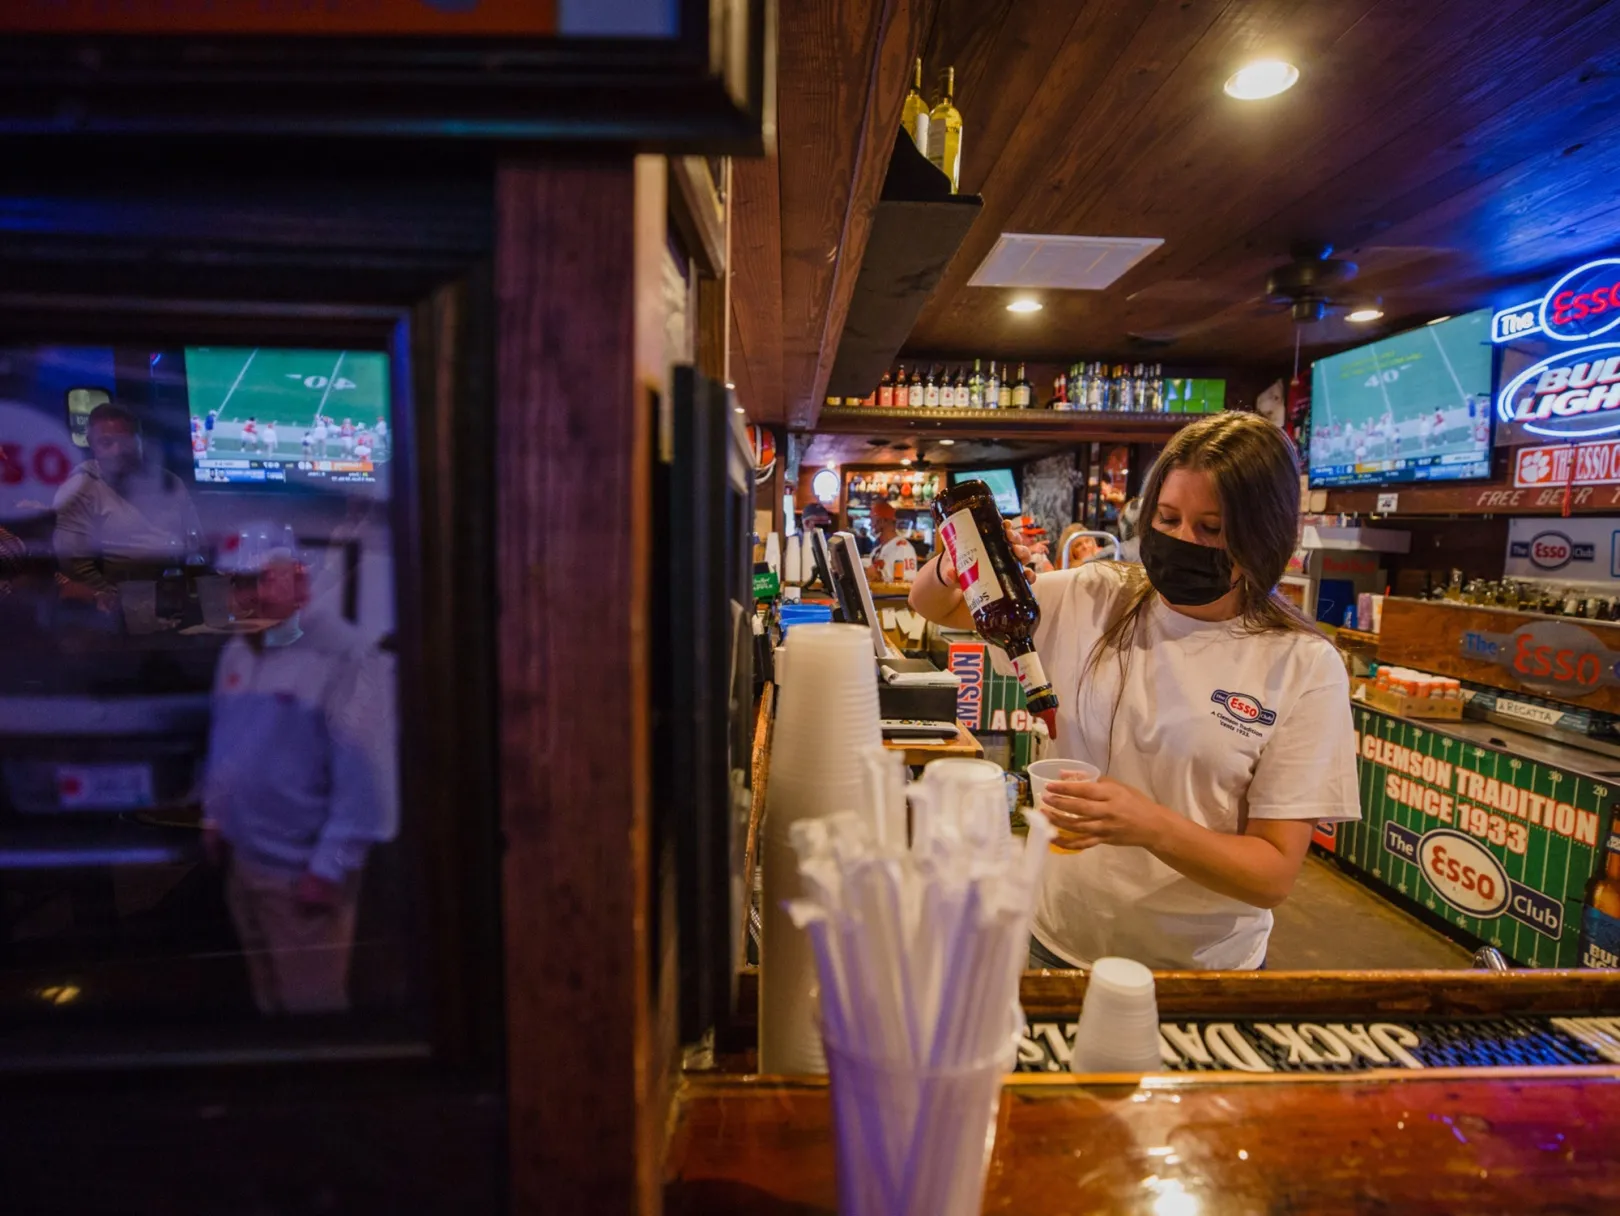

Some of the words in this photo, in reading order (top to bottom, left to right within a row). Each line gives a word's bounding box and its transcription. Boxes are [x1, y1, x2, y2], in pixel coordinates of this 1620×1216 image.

[1501, 311, 1534, 335] The
[1576, 445, 1609, 480] ESSO
[1476, 488, 1526, 506] FREE
[1466, 633, 1498, 655] The
[1217, 712, 1239, 726] Clemson
[1239, 723, 1263, 738] Tradition
[1362, 733, 1453, 790] CLEMSON
[1455, 766, 1600, 847] TRADITION
[1385, 773, 1454, 822] SINCE
[1456, 803, 1529, 855] 1933
[1389, 832, 1414, 856] The
[1513, 895, 1558, 929] Club
[1254, 1022, 1424, 1069] JACK
